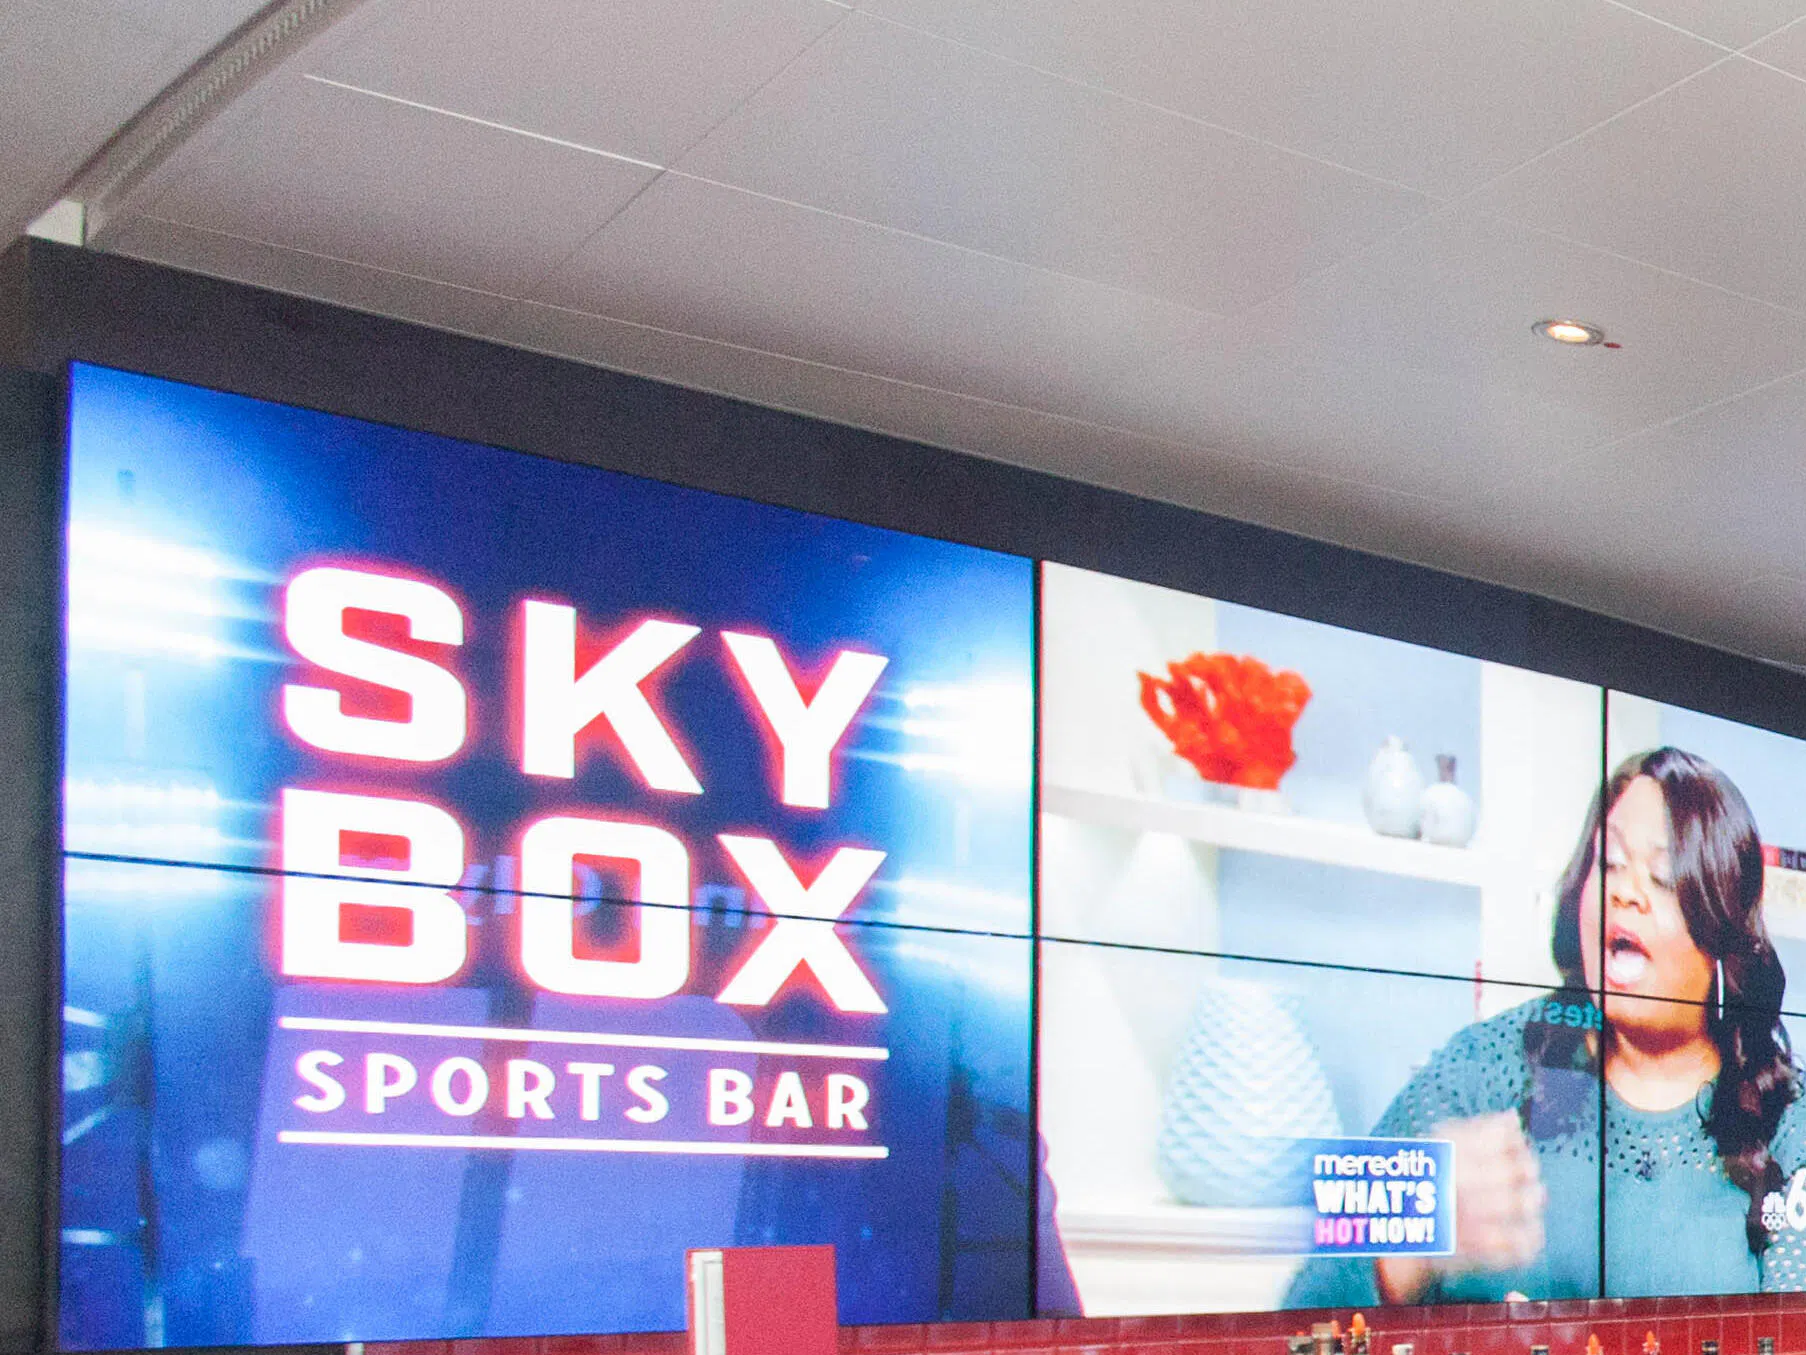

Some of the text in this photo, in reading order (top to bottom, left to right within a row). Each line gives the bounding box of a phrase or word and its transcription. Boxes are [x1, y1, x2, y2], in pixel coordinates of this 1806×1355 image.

[282, 566, 889, 809] SKY
[282, 789, 888, 1013] BOX
[295, 1049, 870, 1132] SPORTS BAR
[1313, 1179, 1436, 1214] WHAT'S
[1314, 1149, 1436, 1177] meredith
